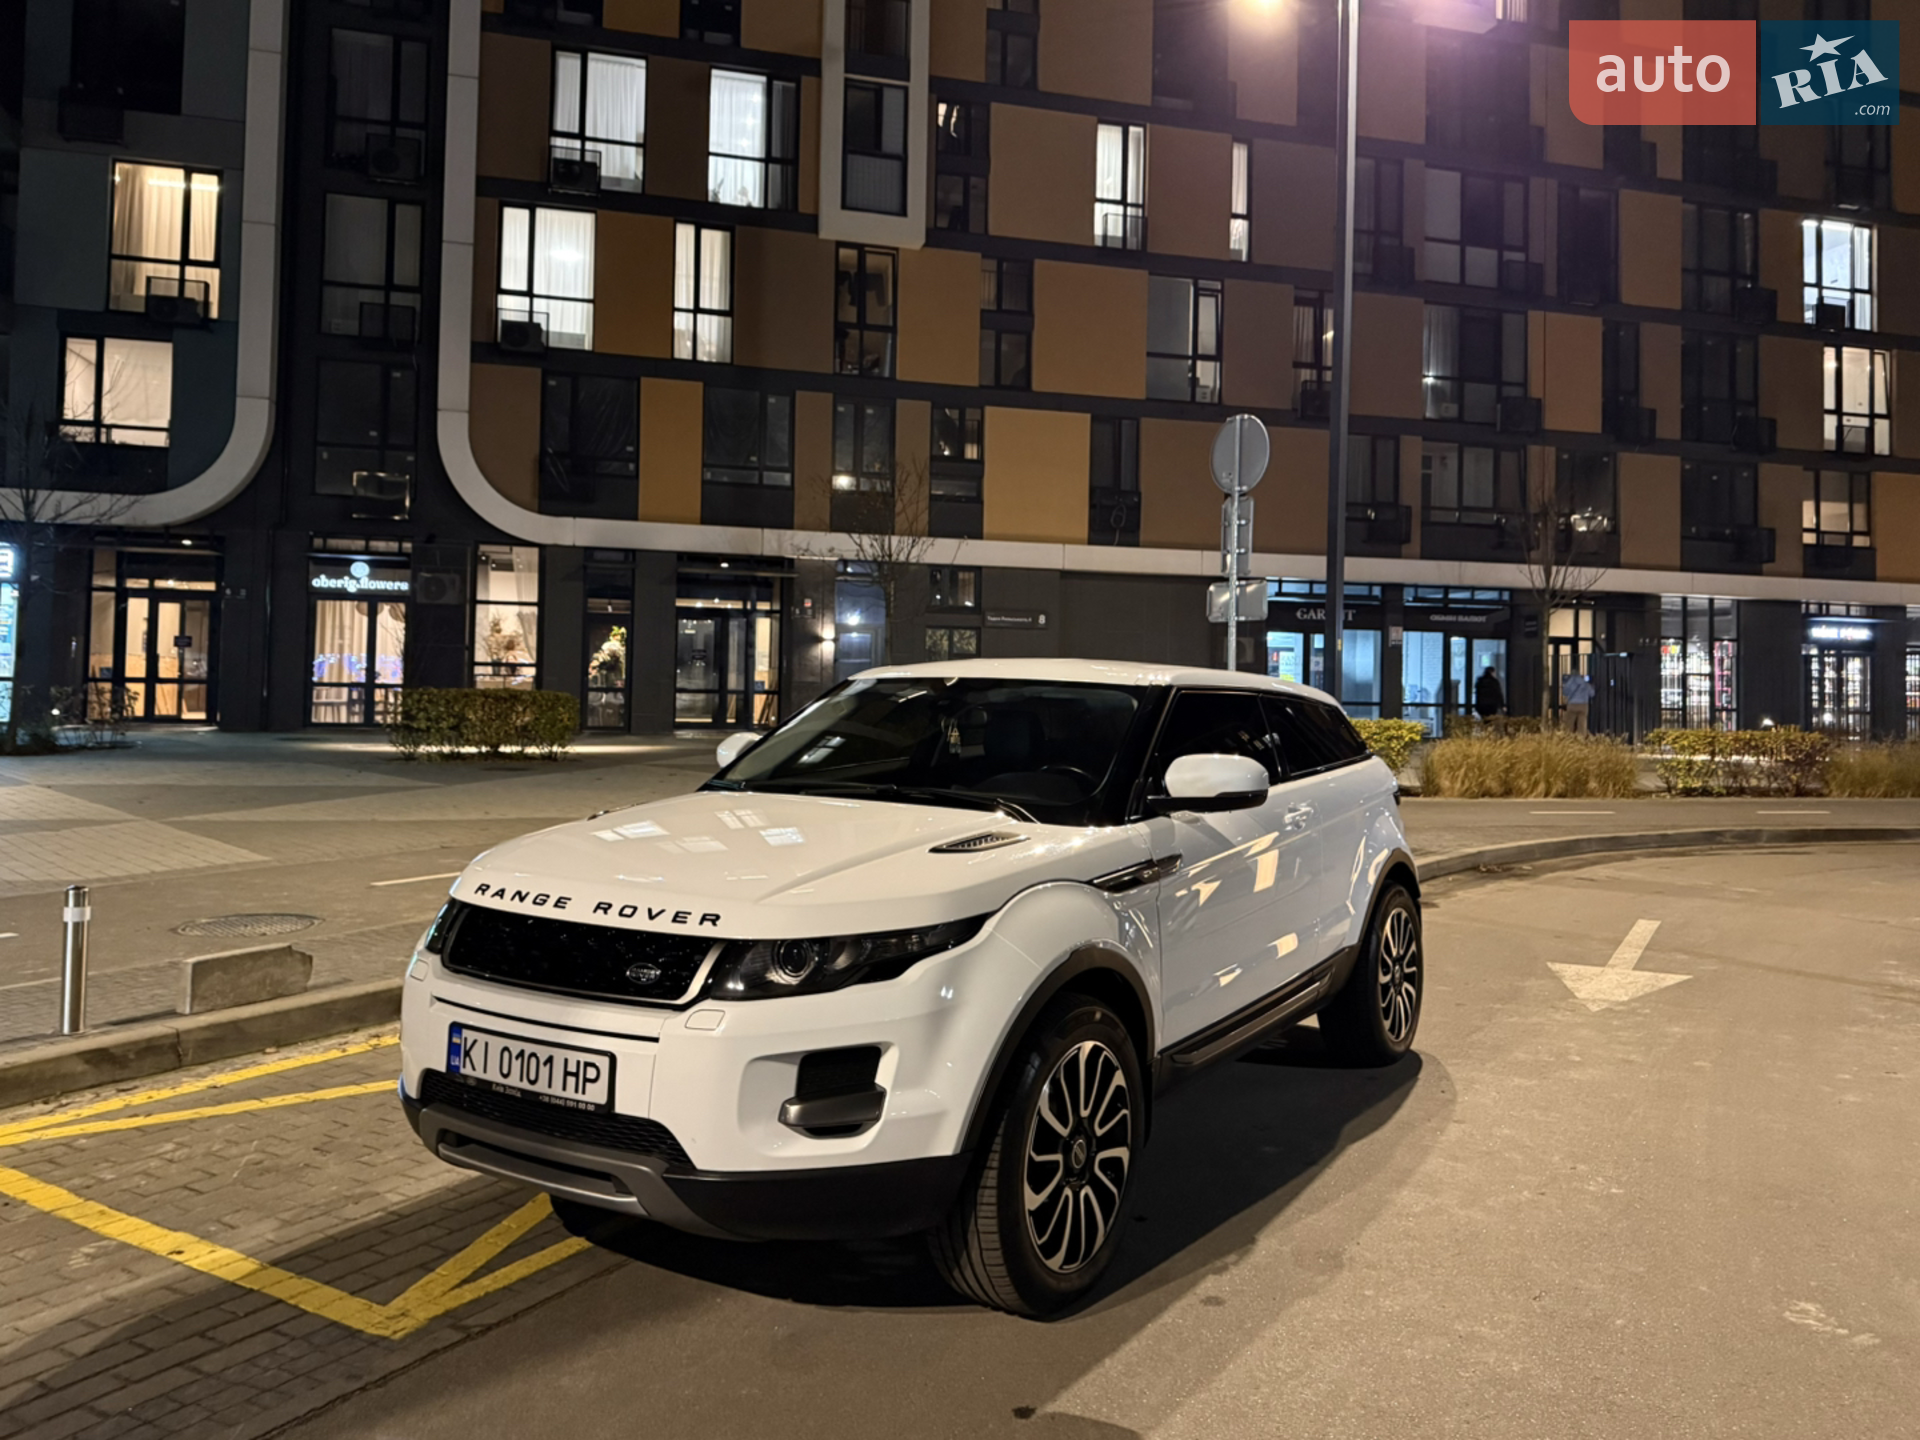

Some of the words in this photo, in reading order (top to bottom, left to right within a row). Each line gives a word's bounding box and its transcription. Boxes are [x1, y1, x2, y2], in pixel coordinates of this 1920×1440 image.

[1295, 607, 1357, 622] GART
[474, 882, 572, 910] RANGE
[593, 901, 721, 927] ROVER
[450, 1055, 460, 1067] UA
[462, 1036, 489, 1074] KI
[498, 1045, 554, 1089] 0101
[562, 1057, 601, 1096] HP
